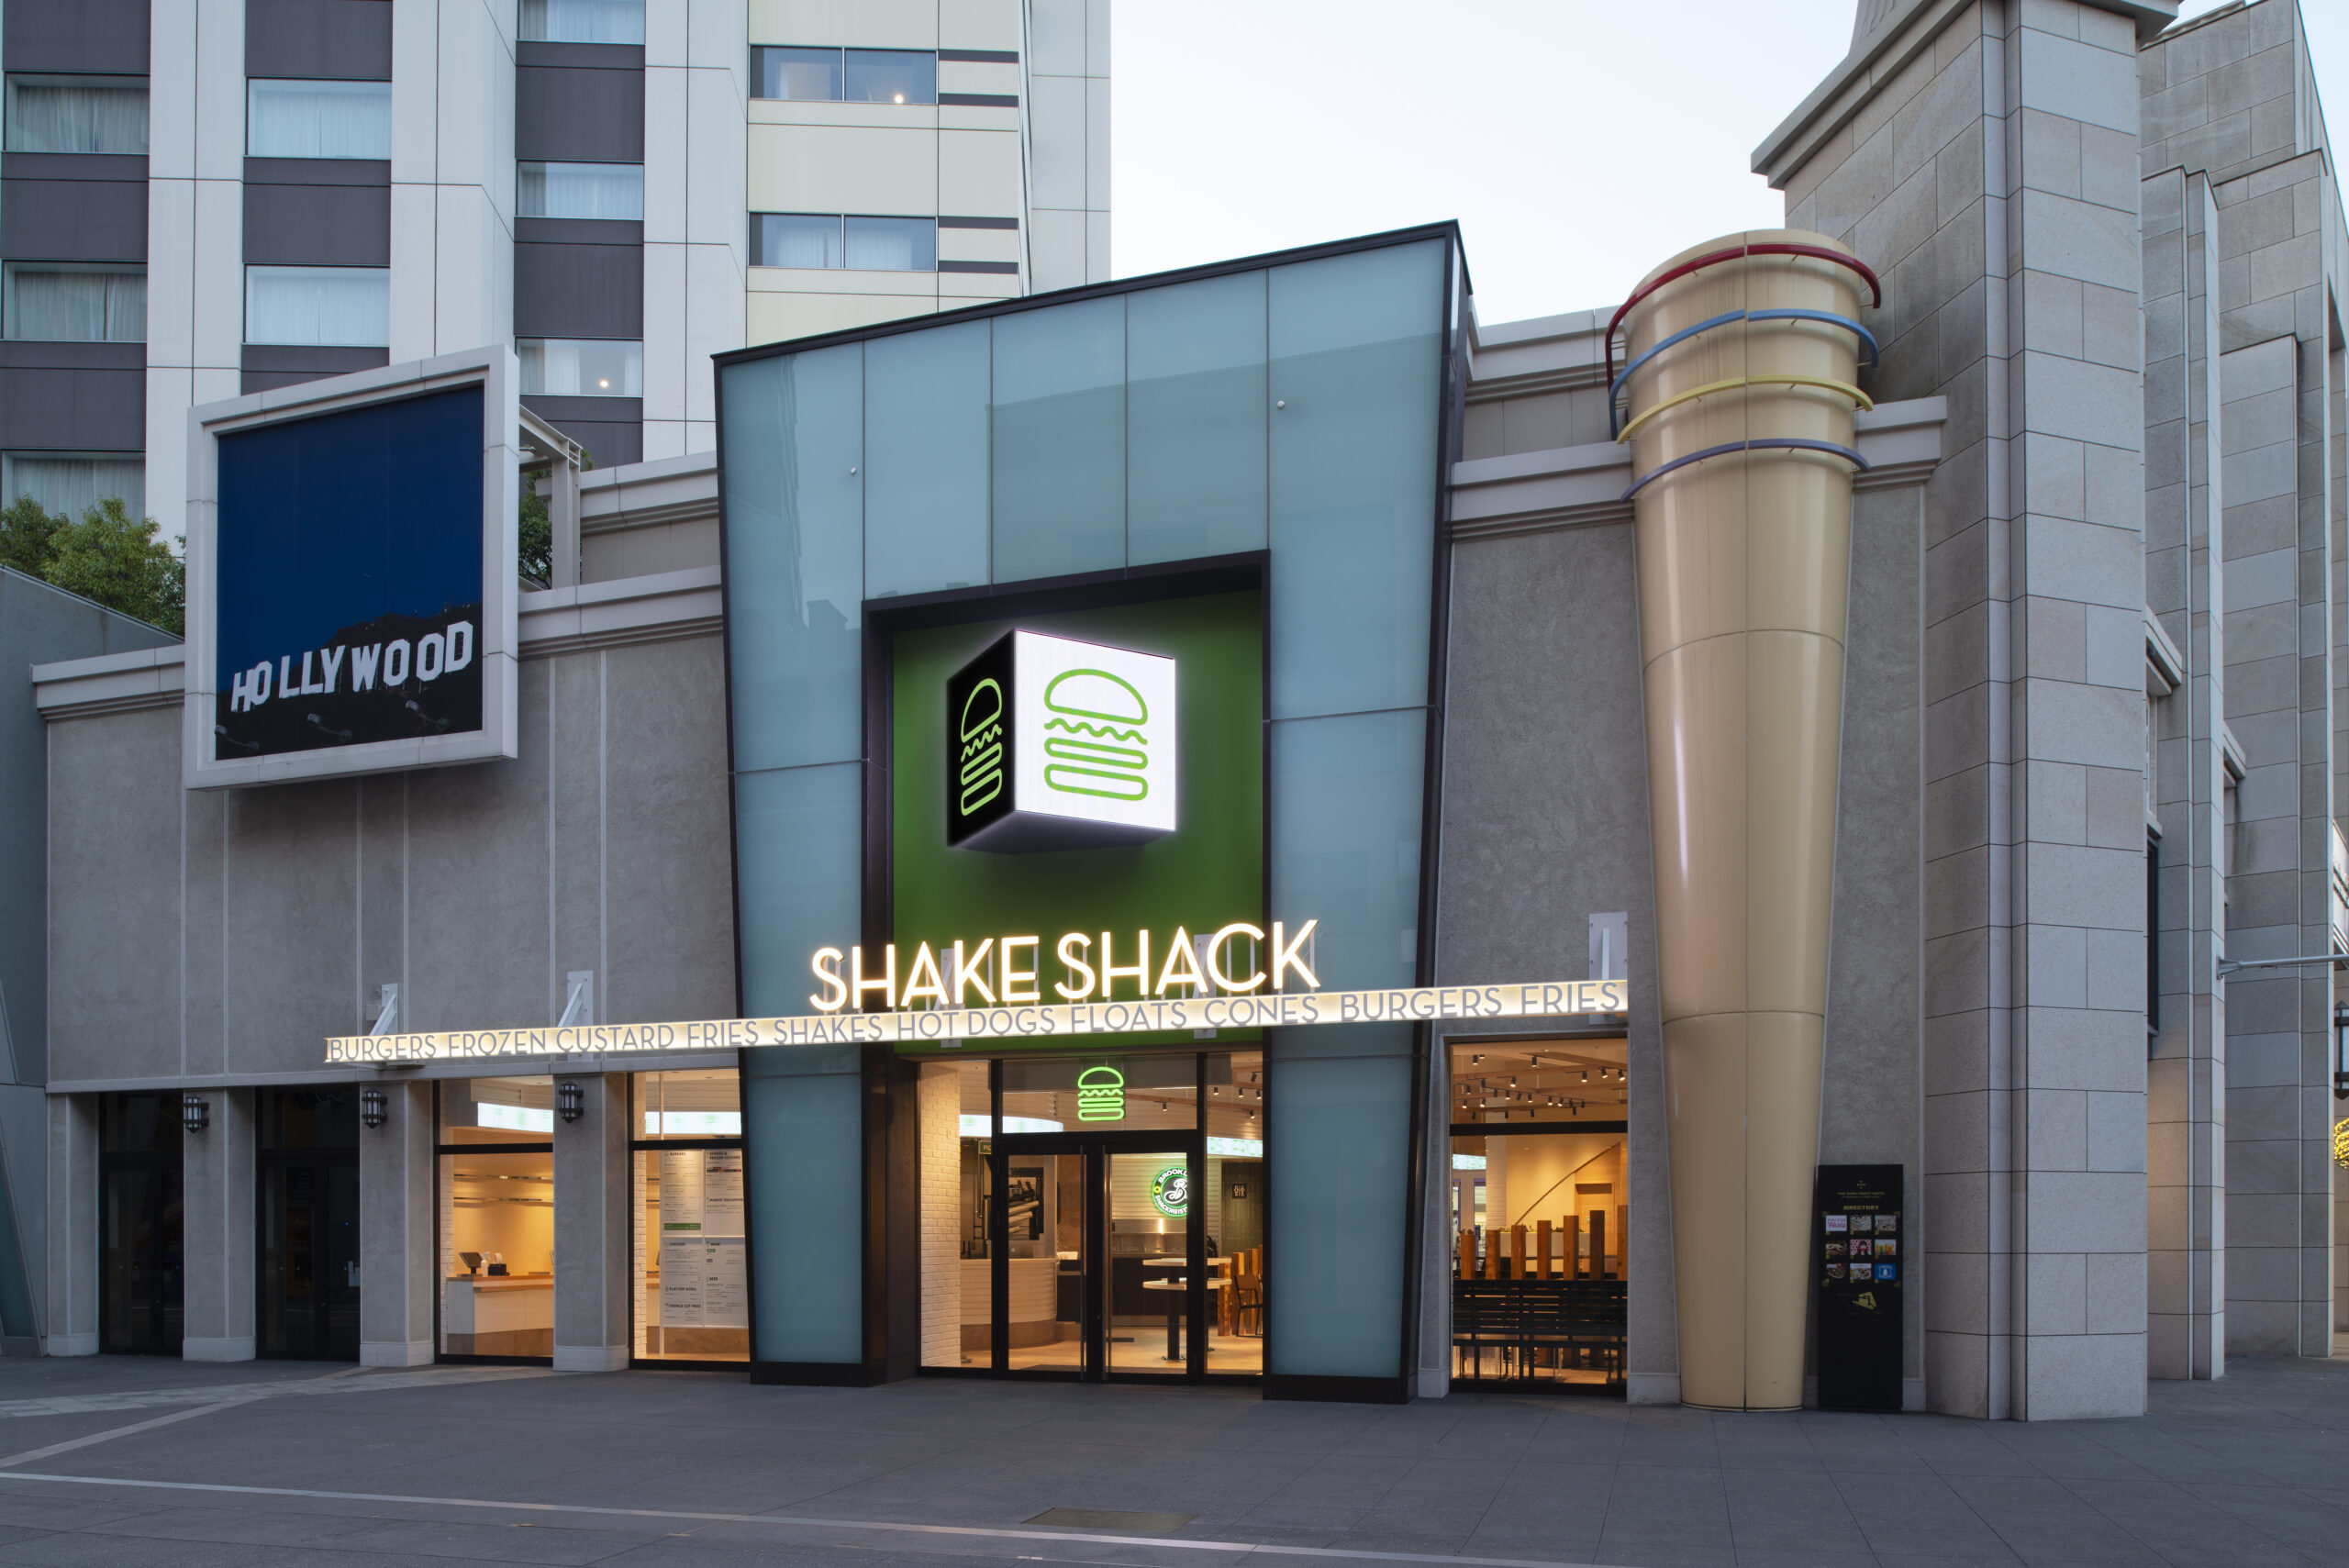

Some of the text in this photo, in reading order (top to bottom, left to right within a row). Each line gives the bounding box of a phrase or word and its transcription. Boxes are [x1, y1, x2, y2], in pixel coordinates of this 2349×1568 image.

[230, 620, 473, 713] HOLLYWOOD
[809, 919, 1321, 1011] SHAKE SHACK
[329, 981, 1620, 1062] BURGERS FROZEN CUSTARD FRIES SHAKES HOT DOGS FLOATS CONES BURGERS FRIES
[1154, 1195, 1187, 1215] SHACKMEIST
[1158, 1169, 1187, 1184] BROOKL
